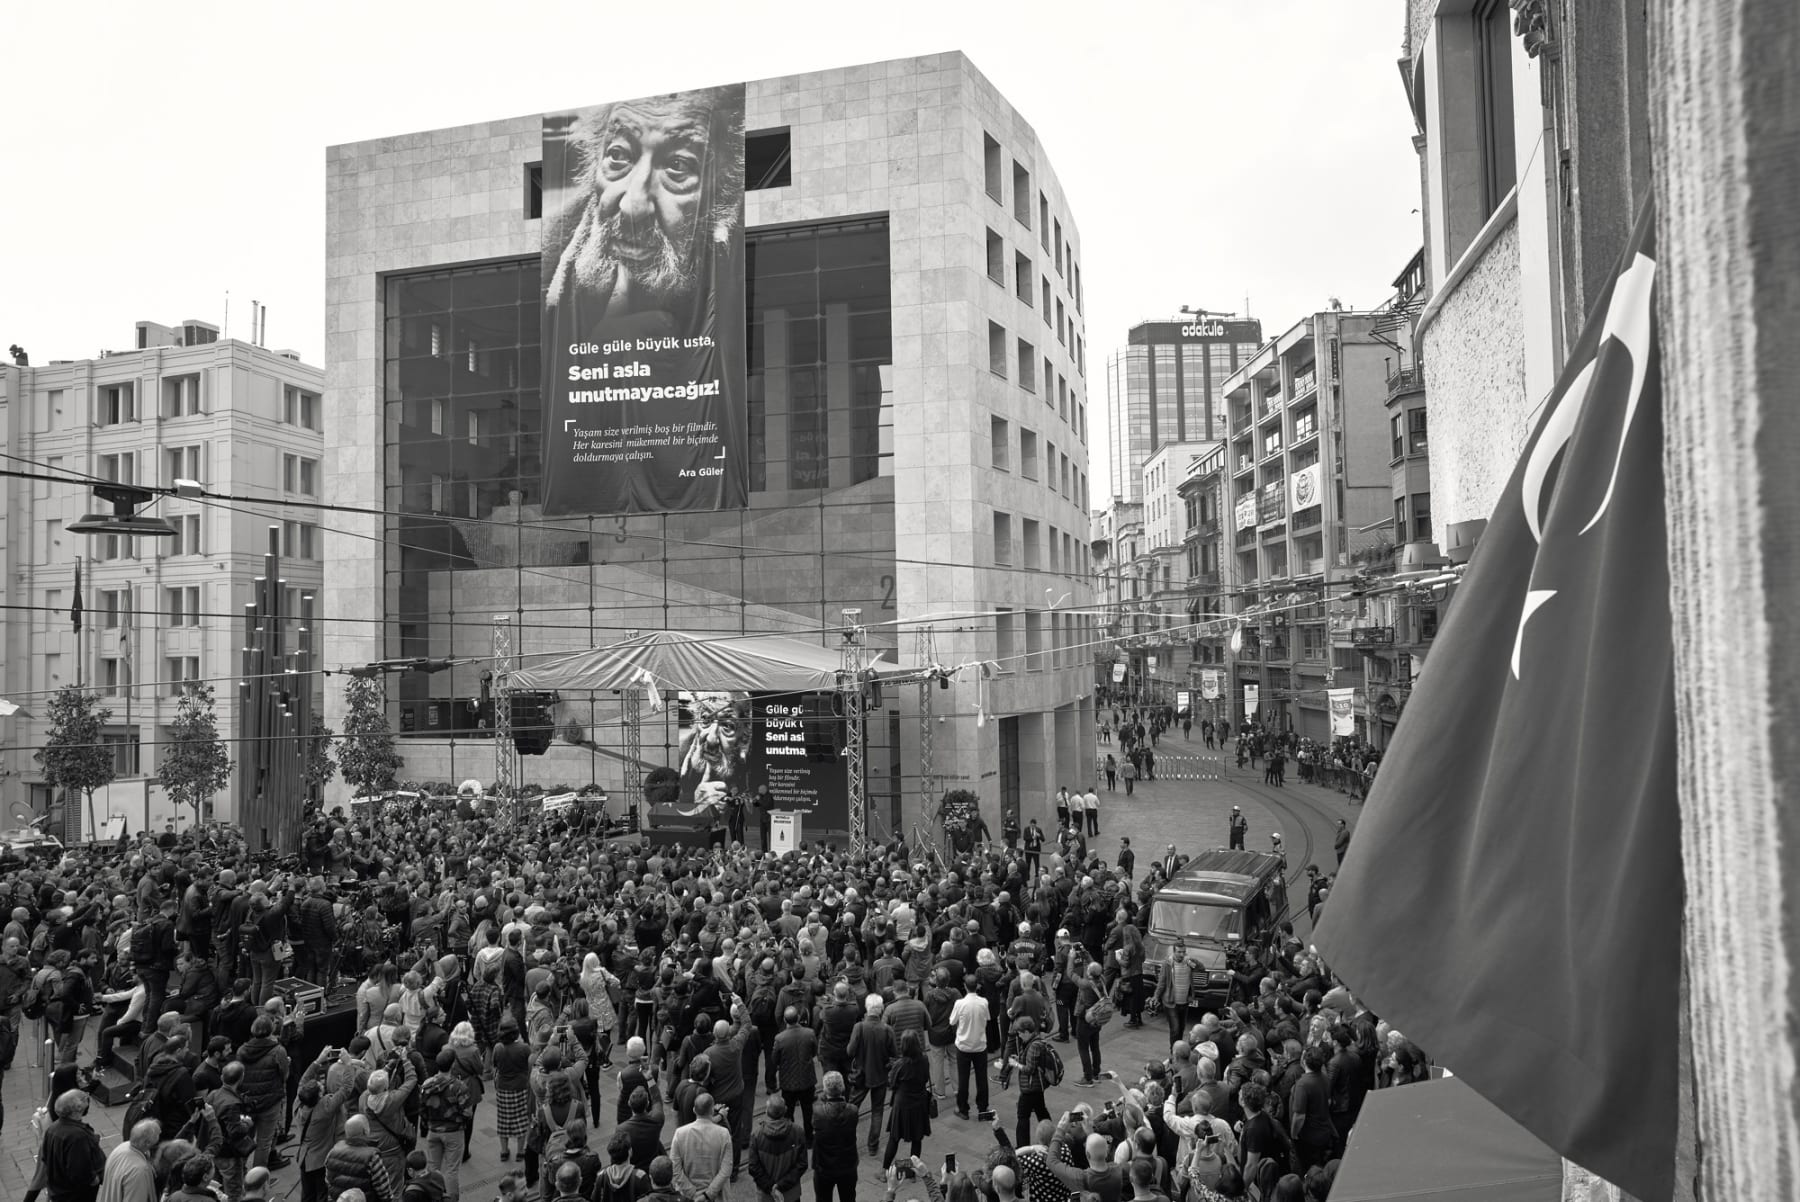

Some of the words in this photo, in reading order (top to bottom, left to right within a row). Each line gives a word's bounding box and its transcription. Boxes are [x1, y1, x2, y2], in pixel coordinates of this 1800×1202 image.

[1182, 321, 1224, 336] adakule
[569, 343, 598, 356] Güle
[604, 340, 632, 355] güle
[636, 337, 679, 352] büyük
[684, 336, 715, 349] usta,
[568, 364, 608, 381] Seni
[613, 362, 650, 378] asla
[568, 380, 720, 404] unutmayacağız!
[573, 428, 602, 439] Yaşam
[604, 427, 619, 436] size
[621, 424, 653, 436] verilmiş
[655, 423, 670, 435] boş
[672, 423, 685, 432] bir
[686, 422, 718, 434] filmdir.
[573, 440, 589, 450] Her
[591, 438, 623, 449] karesini
[626, 436, 670, 448] mükemmel
[672, 435, 685, 445] bir
[687, 434, 719, 446] biçimde
[573, 451, 624, 464] doldurmaya
[625, 450, 654, 462] çalışın.
[679, 468, 696, 478] Ara
[698, 467, 724, 477] Güler
[880, 575, 895, 610] 2
[766, 704, 789, 714] Güle
[791, 704, 804, 716] gü
[766, 718, 796, 730] büyük
[766, 732, 788, 742] Seni
[790, 732, 804, 742] asl
